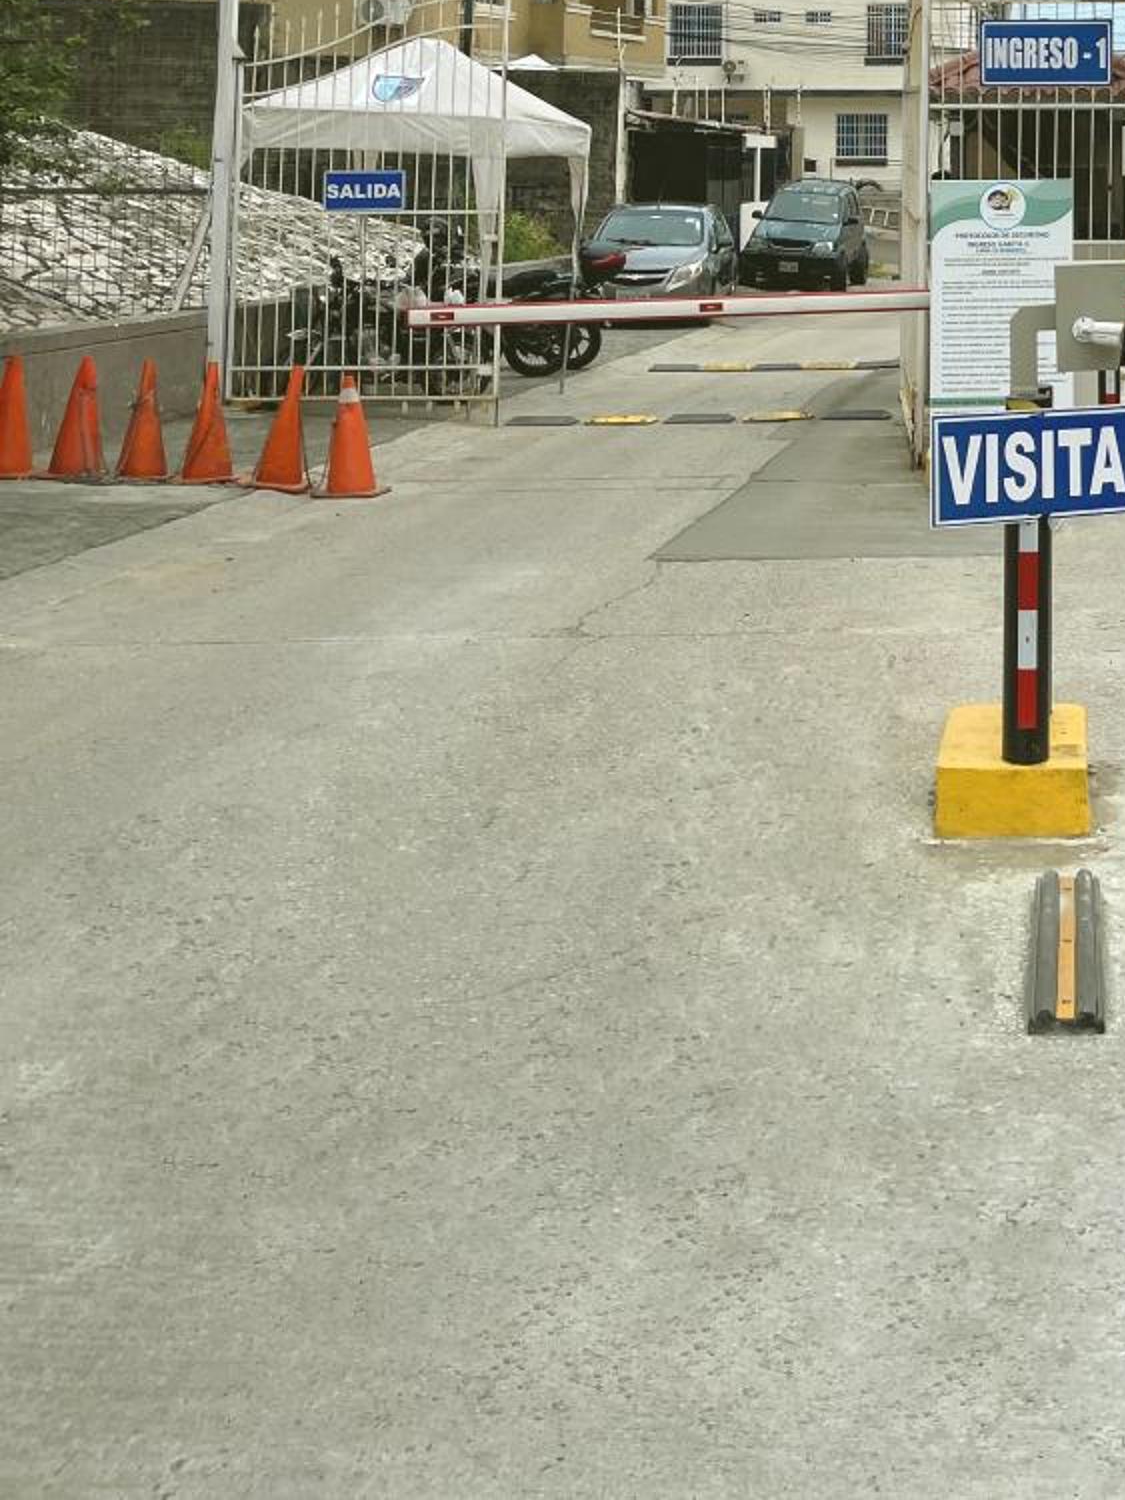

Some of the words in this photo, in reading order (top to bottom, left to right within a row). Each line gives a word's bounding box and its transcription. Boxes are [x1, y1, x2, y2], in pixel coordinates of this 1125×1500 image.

[985, 36, 1079, 69] INGRESO
[1096, 37, 1107, 69] 1
[327, 183, 401, 199] SALIDA
